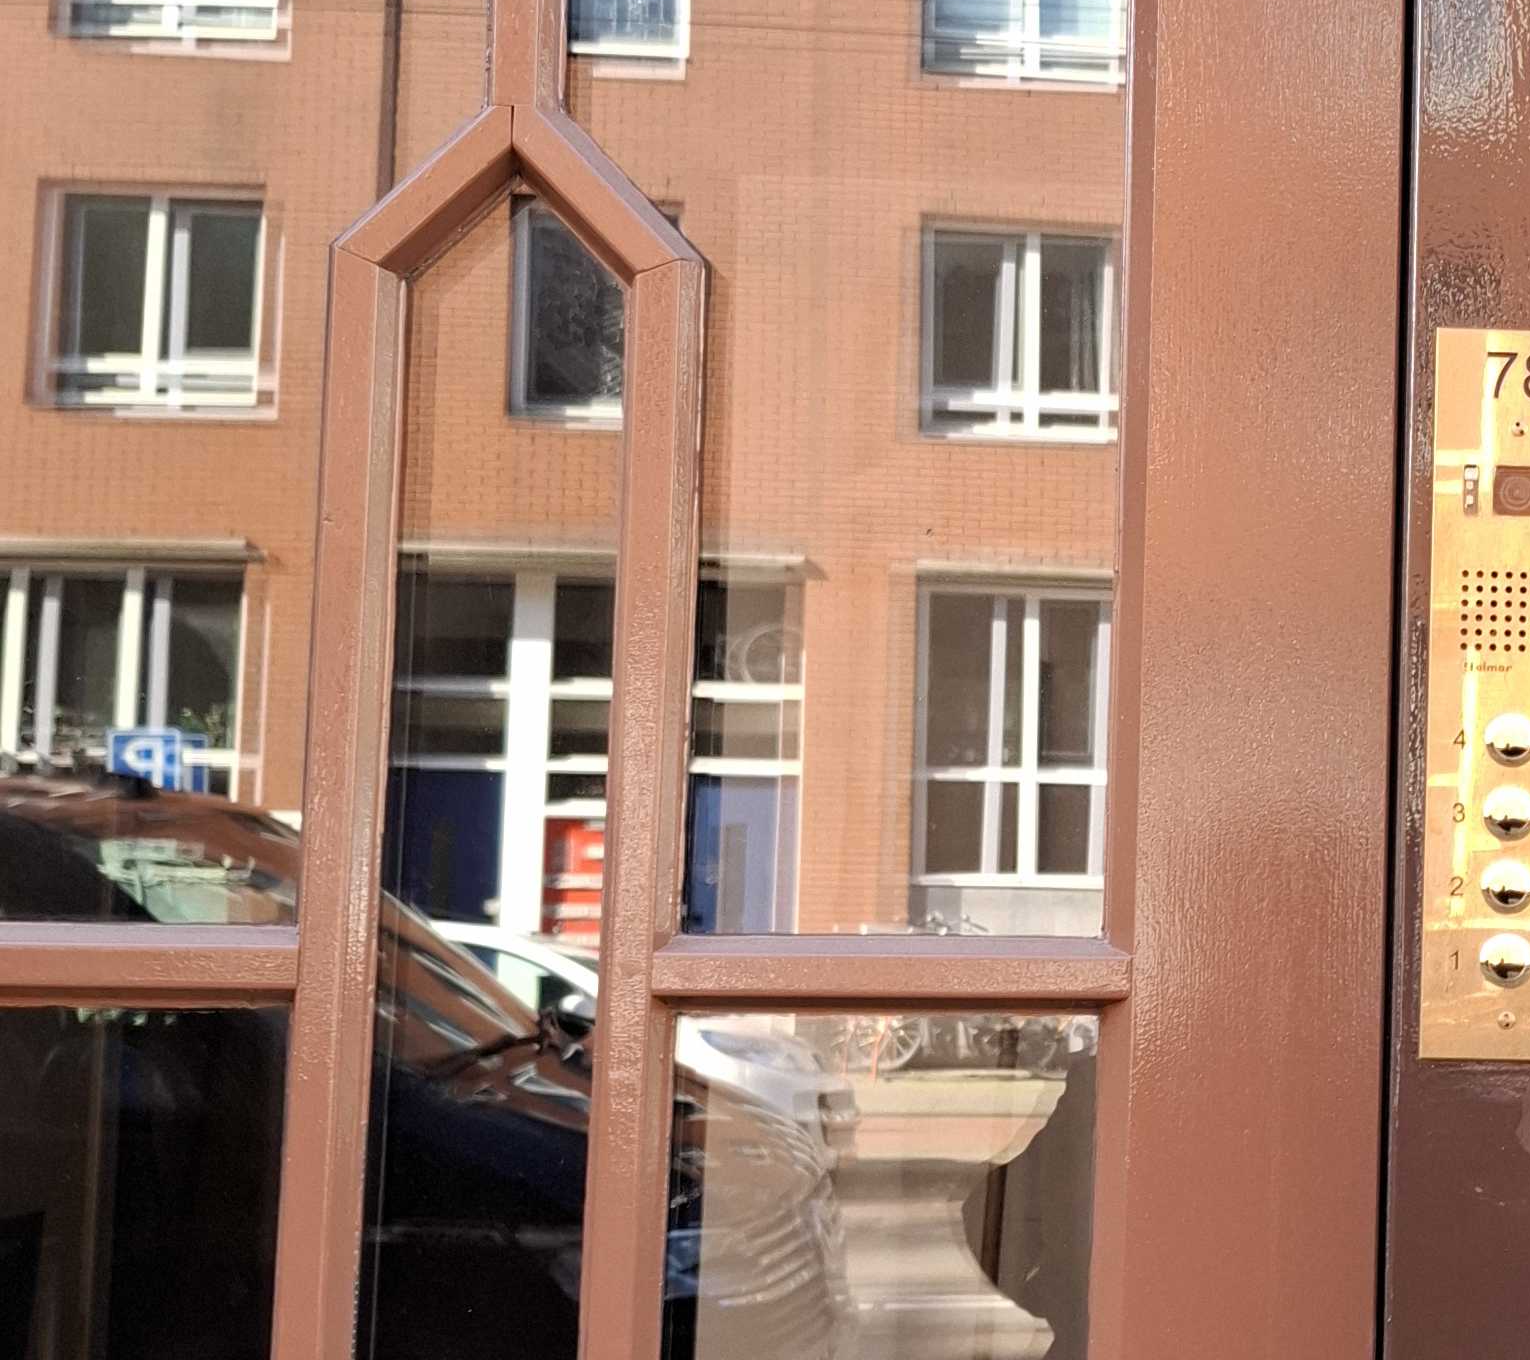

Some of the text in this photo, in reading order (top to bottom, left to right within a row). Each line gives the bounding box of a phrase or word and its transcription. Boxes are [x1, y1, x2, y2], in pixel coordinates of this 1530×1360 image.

[1453, 728, 1466, 750] 4
[1452, 802, 1465, 823] 3
[1450, 876, 1464, 897] 2
[1450, 950, 1460, 971] 1
